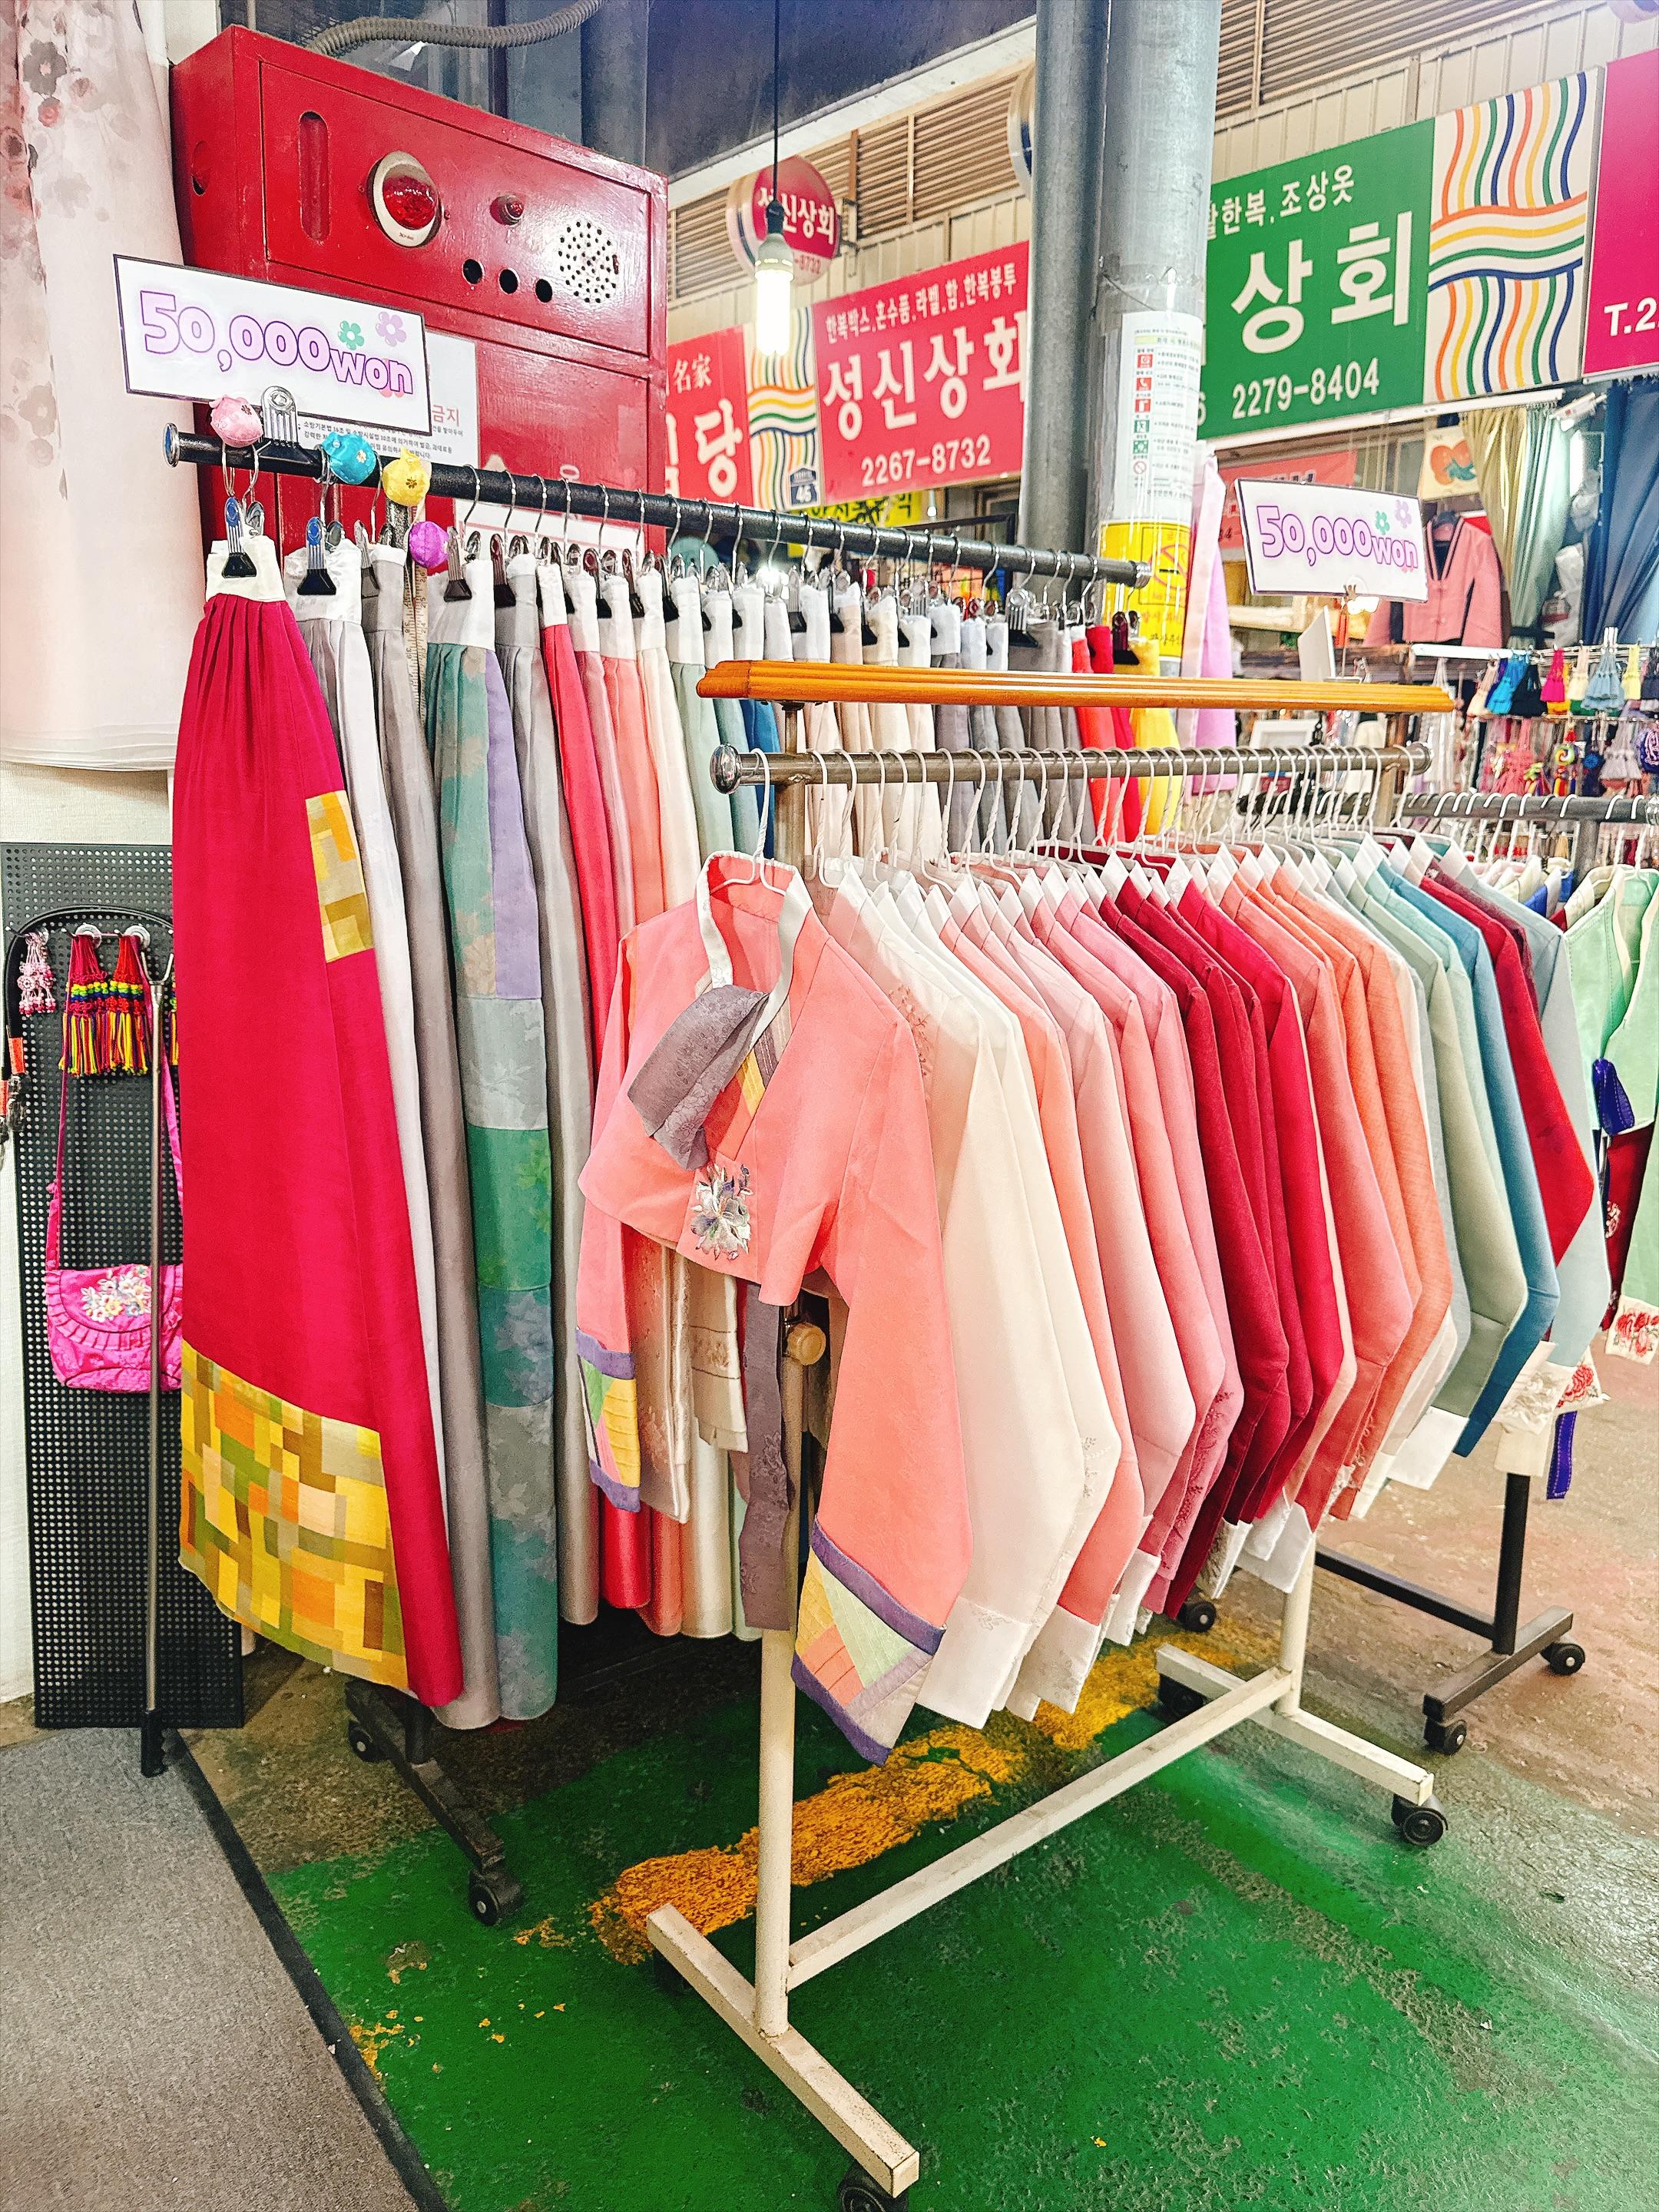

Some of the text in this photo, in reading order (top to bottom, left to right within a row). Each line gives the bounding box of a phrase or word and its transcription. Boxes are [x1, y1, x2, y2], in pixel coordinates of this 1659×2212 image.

[1201, 210, 1412, 366] 상회
[1603, 296, 1659, 337] T.2
[140, 290, 413, 395] 50,000won
[667, 353, 712, 396] 名家
[823, 310, 1028, 441] 성신상회
[1232, 357, 1380, 419] 2279-8404
[432, 404, 460, 427] 금지
[860, 434, 992, 487] 2267-8732
[1256, 505, 1419, 569] 50,000won
